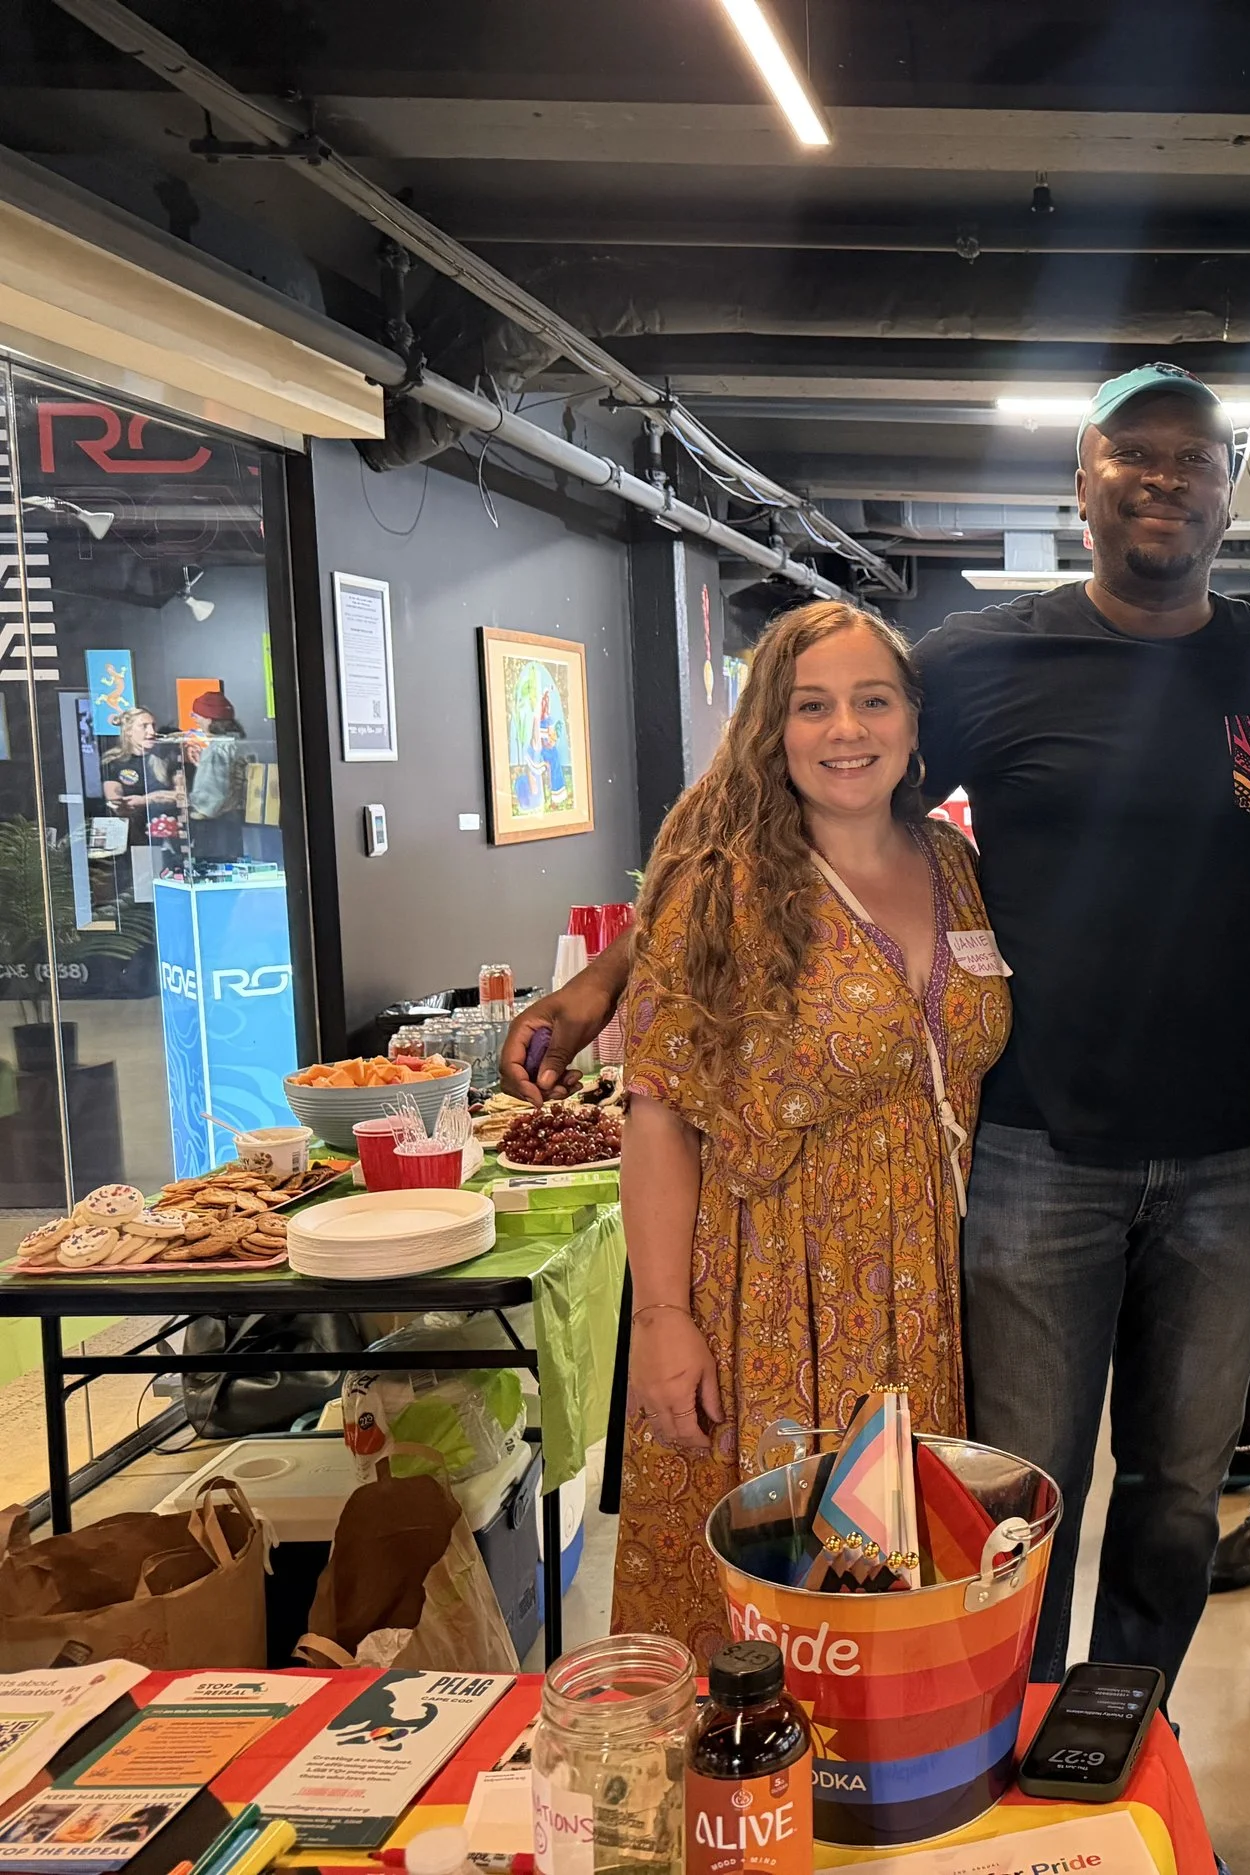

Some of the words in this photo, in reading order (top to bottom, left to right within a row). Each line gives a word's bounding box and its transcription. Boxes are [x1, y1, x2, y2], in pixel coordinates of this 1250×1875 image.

[953, 935, 989, 952] JAMIE
[162, 961, 198, 1000] ROVE
[426, 1676, 495, 1697] PFLAG
[1047, 1748, 1105, 1767] 6:27
[78, 1792, 150, 1800] MARIJUANA
[152, 1791, 191, 1799] LEGAL
[695, 1801, 794, 1850] ALIVE
[33, 1847, 66, 1856] THE
[66, 1846, 130, 1855] REPEAL
[1031, 1854, 1102, 1875] Pride
